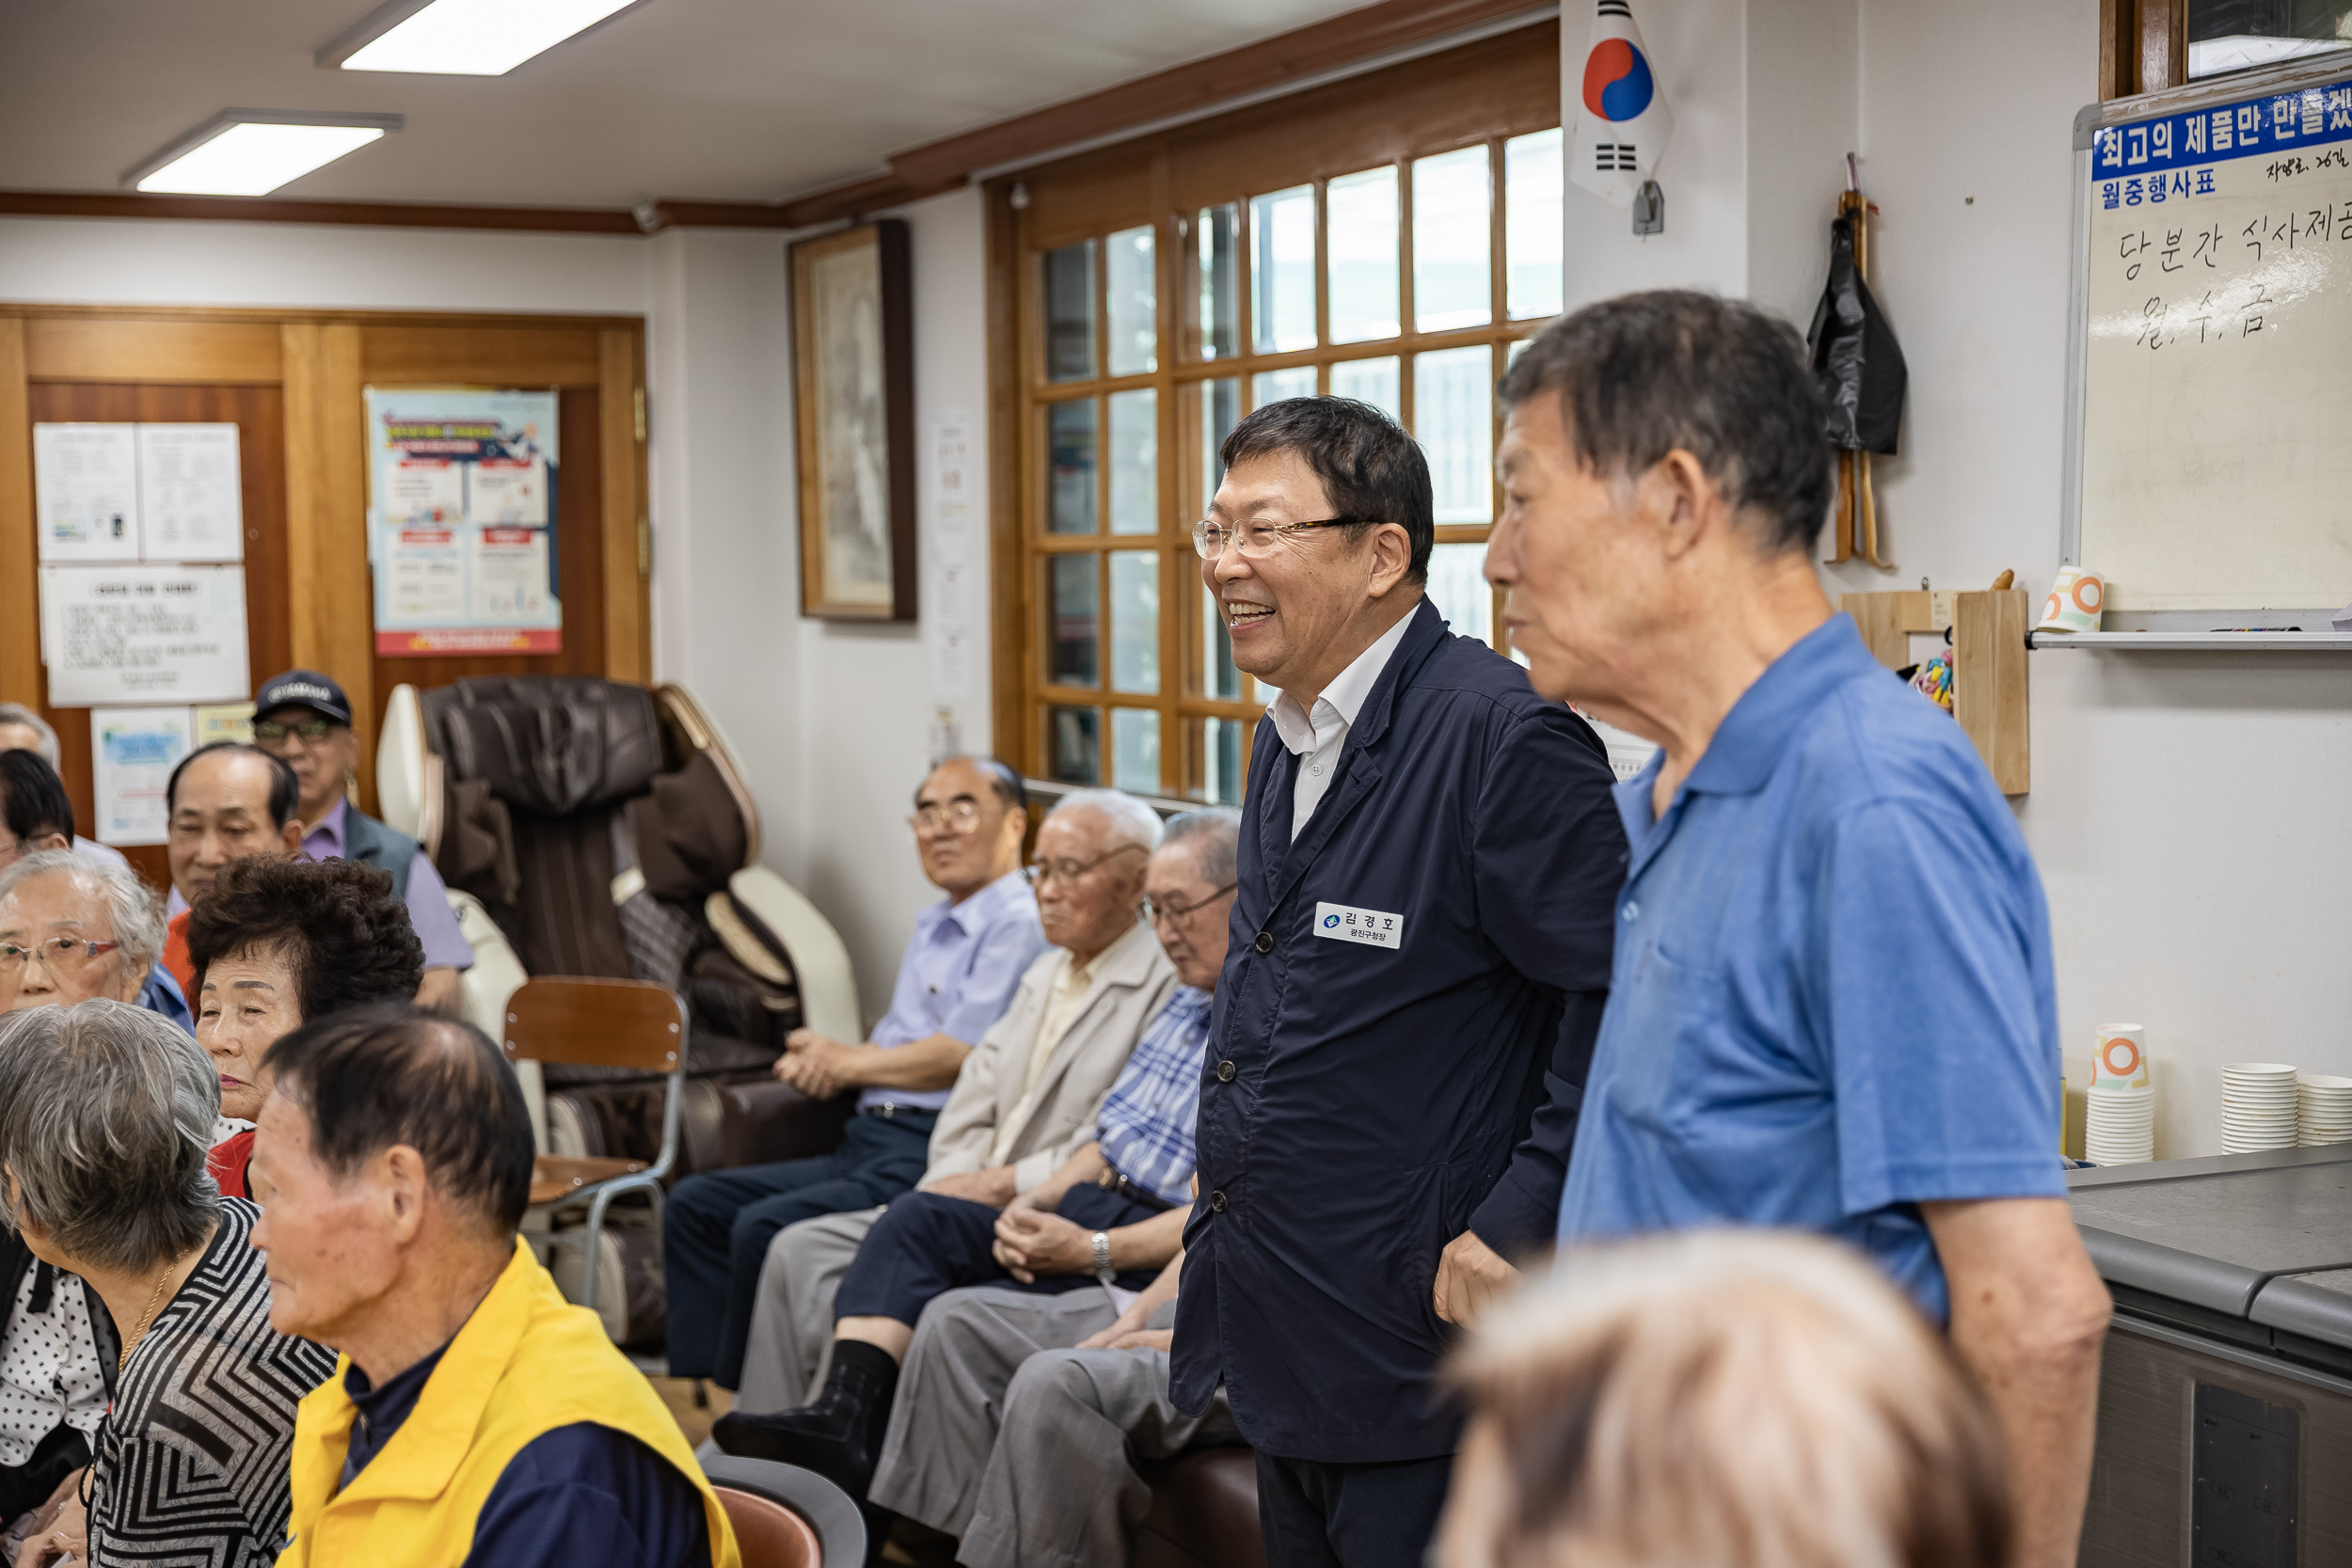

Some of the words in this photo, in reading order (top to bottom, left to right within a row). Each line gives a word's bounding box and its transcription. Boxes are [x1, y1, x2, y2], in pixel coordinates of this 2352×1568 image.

[2101, 119, 2173, 168] 최고의
[2185, 103, 2263, 155] 제품만
[2273, 87, 2352, 141] 만들겠
[2101, 167, 2217, 211] 월중행사표
[1350, 927, 1387, 942] 광진구청장
